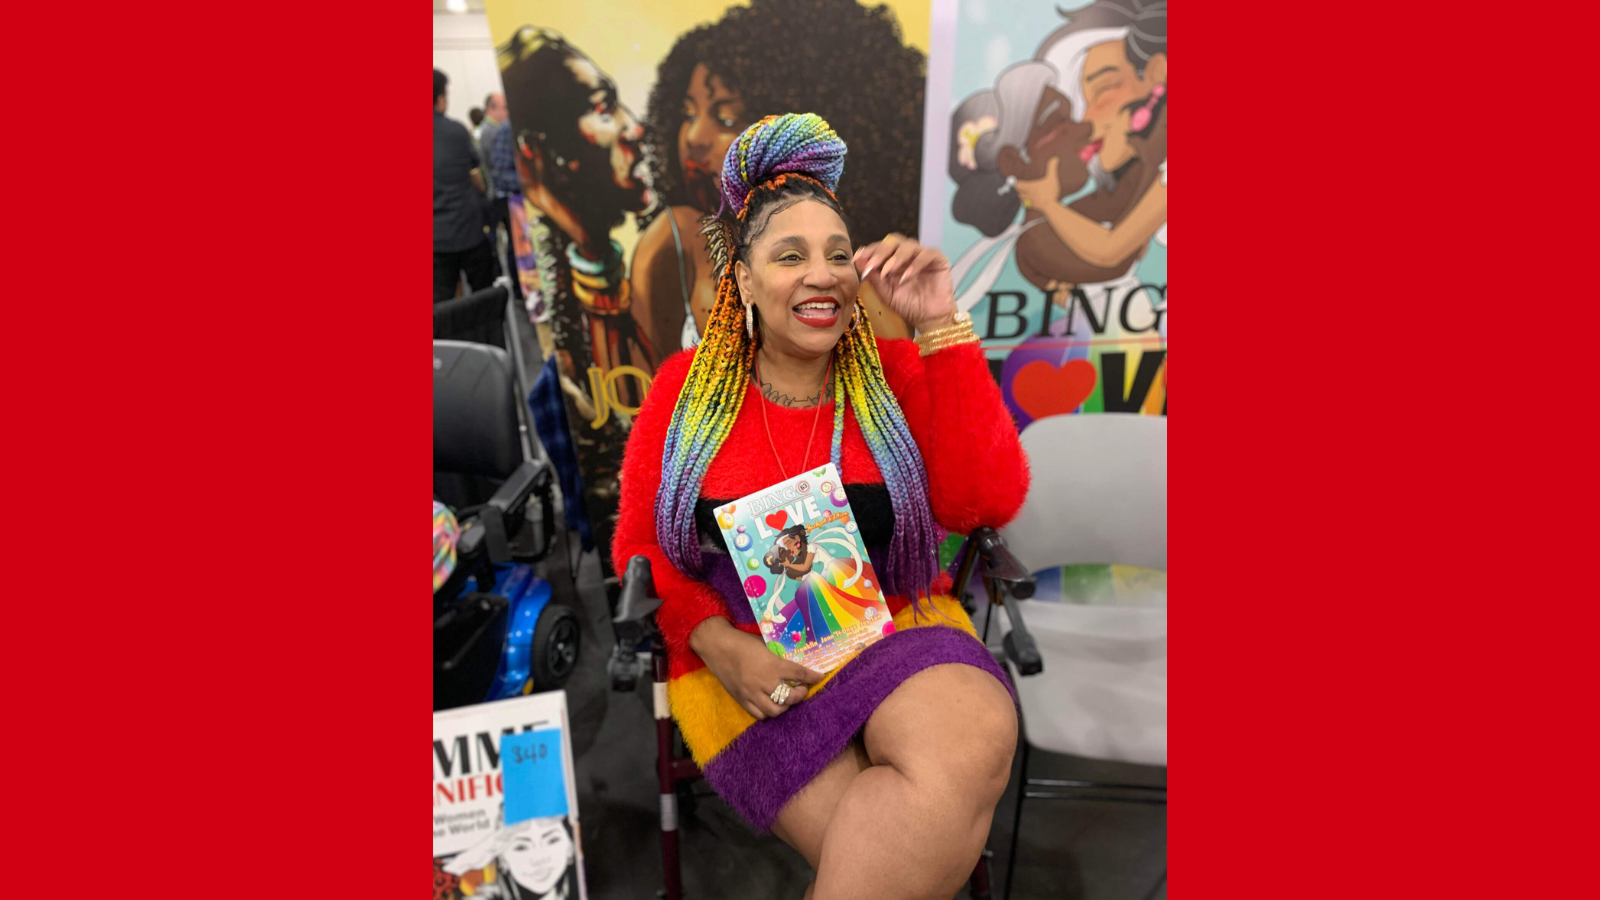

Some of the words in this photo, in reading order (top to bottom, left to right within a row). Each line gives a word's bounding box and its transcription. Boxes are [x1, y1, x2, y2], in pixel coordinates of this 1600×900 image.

[794, 641, 819, 654] Franklin
[511, 743, 548, 764] $40
[448, 818, 491, 834] World
